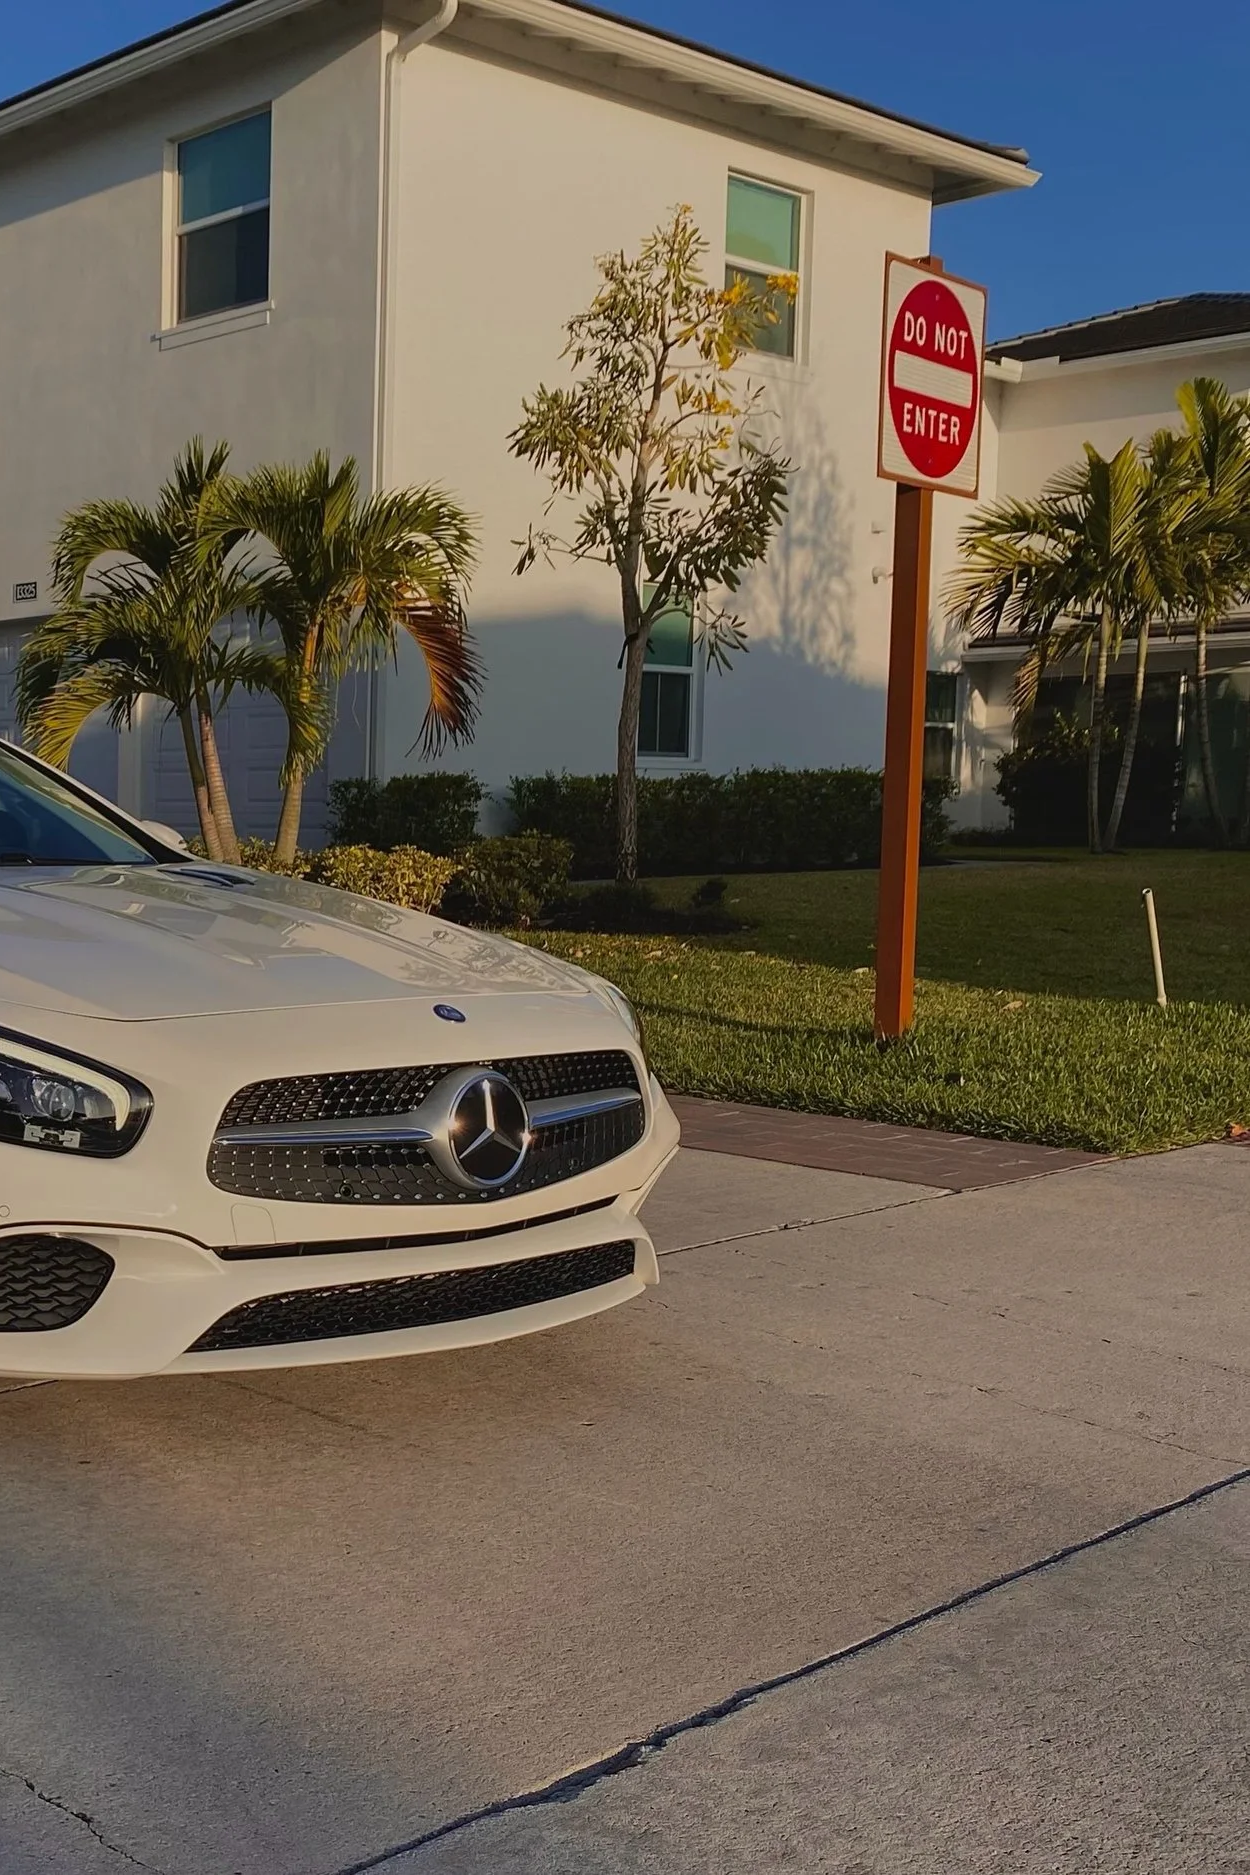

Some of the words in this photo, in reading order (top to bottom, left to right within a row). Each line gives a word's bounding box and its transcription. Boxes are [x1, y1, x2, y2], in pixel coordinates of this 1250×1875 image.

[903, 310, 927, 347] DO
[934, 321, 969, 361] NOT
[902, 401, 961, 446] ENTER
